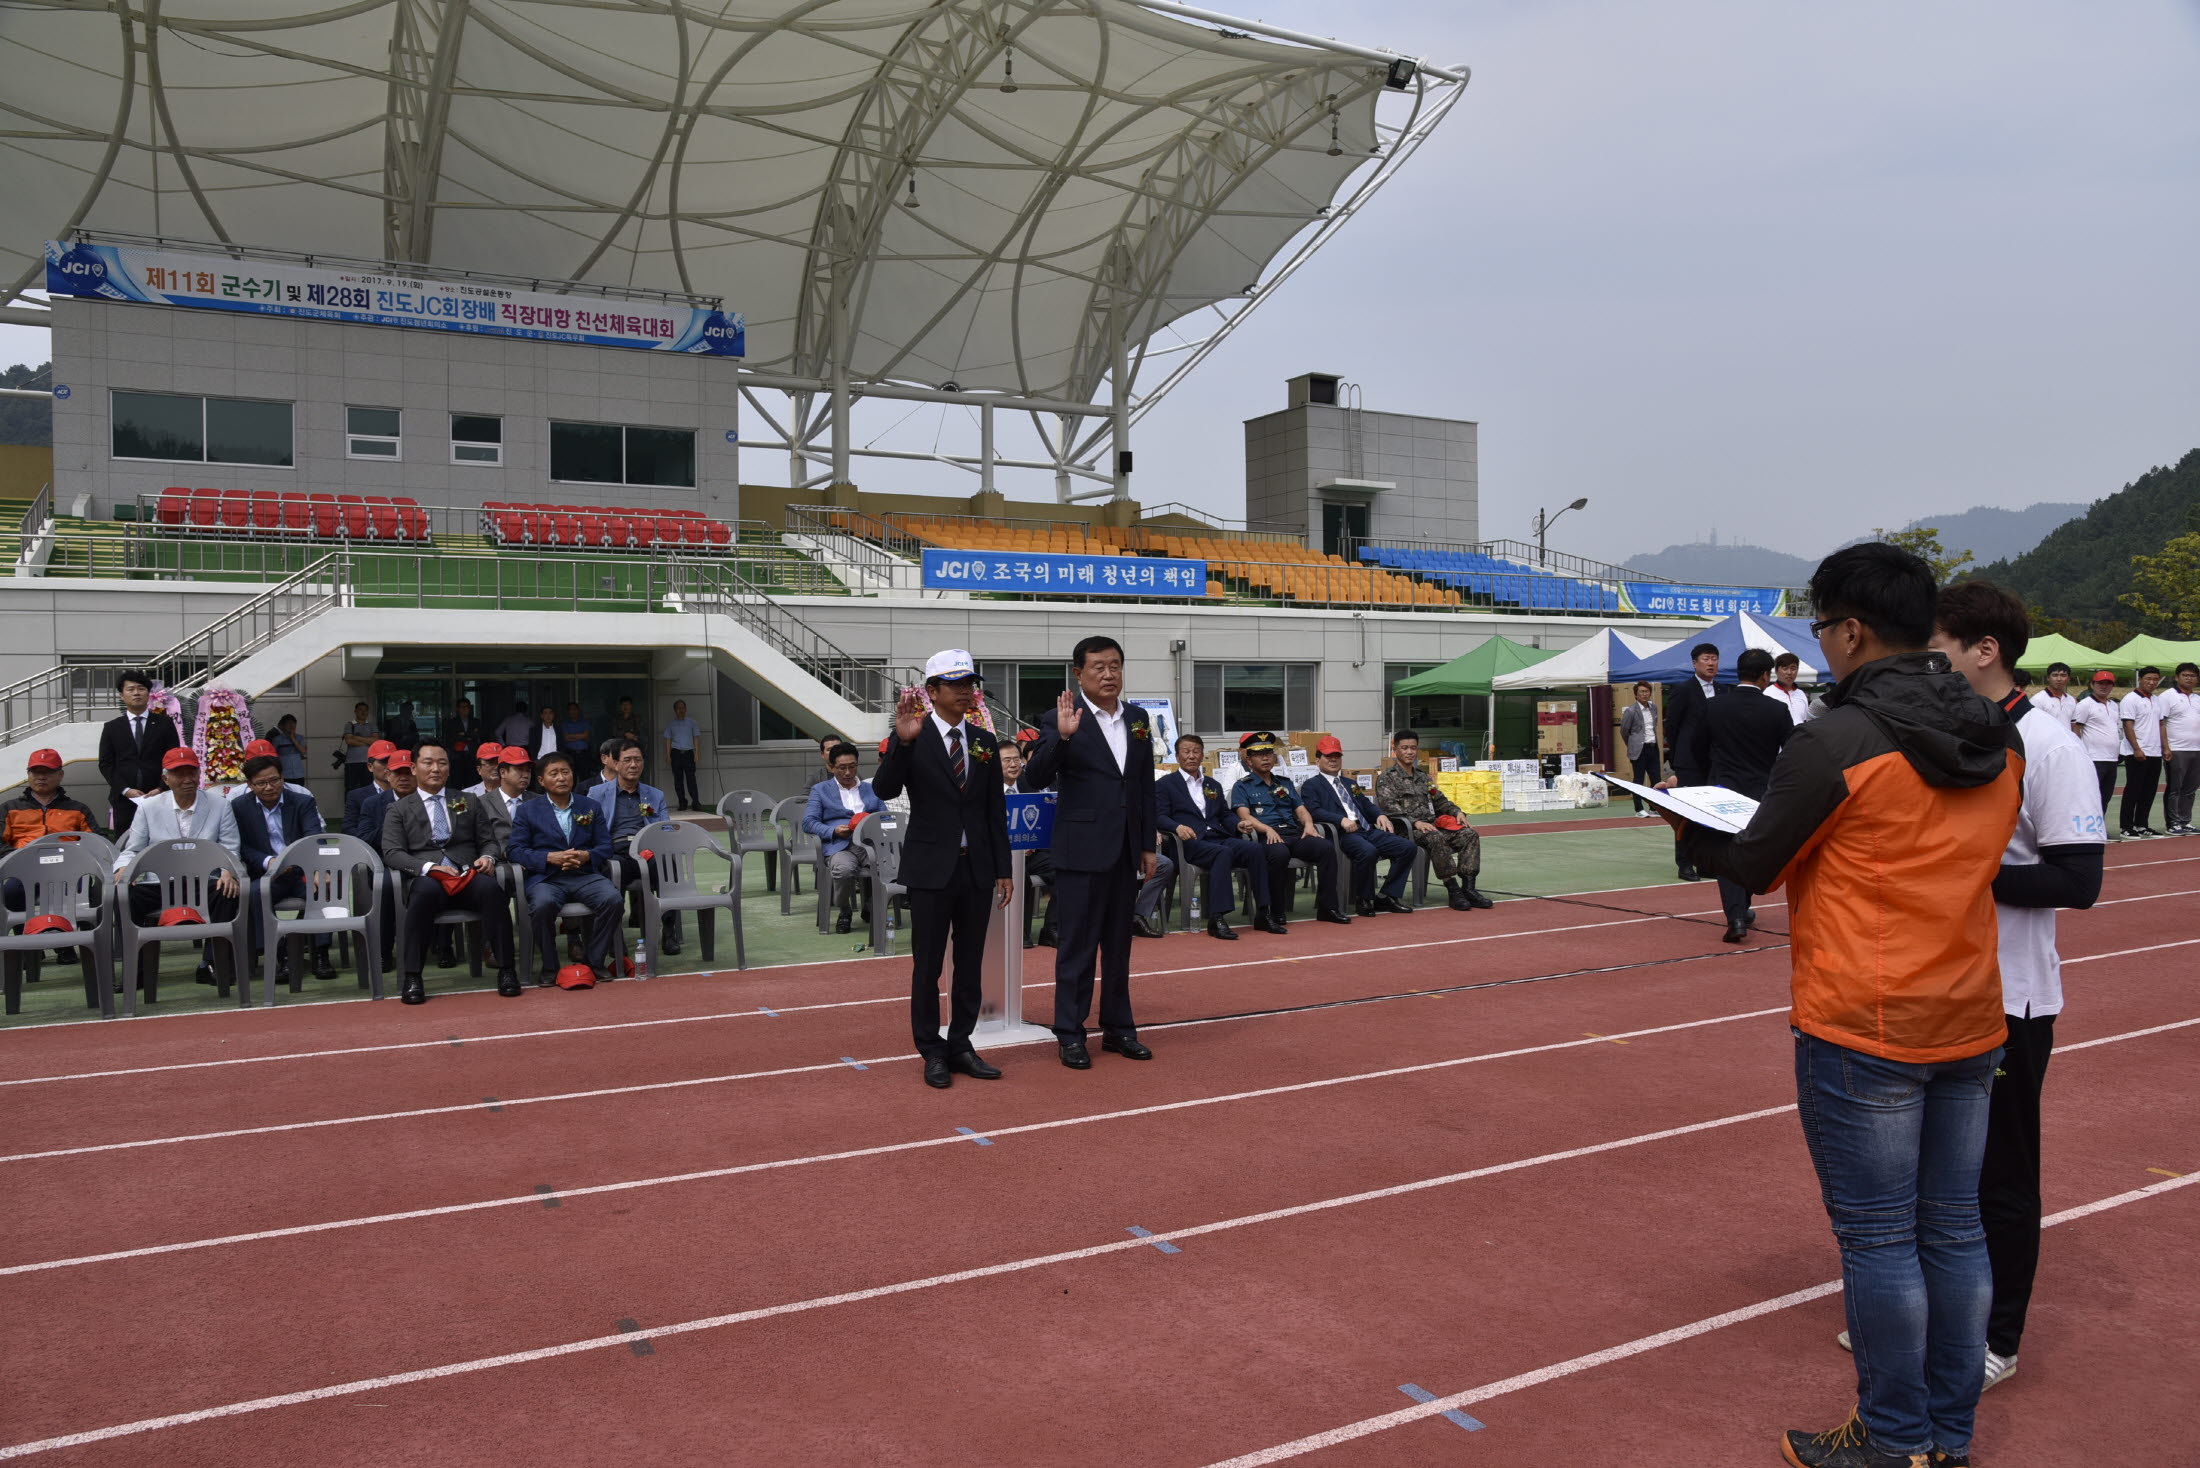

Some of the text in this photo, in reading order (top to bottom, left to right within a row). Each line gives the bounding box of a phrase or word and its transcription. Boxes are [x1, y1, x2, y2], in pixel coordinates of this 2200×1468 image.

[62, 262, 91, 275] JCI
[460, 285, 512, 299] 진도공설운동장
[146, 267, 675, 339] 제11회 군수기 및 제28회 진도JC회장배 직장대항 친선체육대회
[704, 325, 726, 338] JCI
[935, 561, 1196, 588] JCI 조국의 미래 청년의 책임
[1648, 597, 1666, 610] JCI
